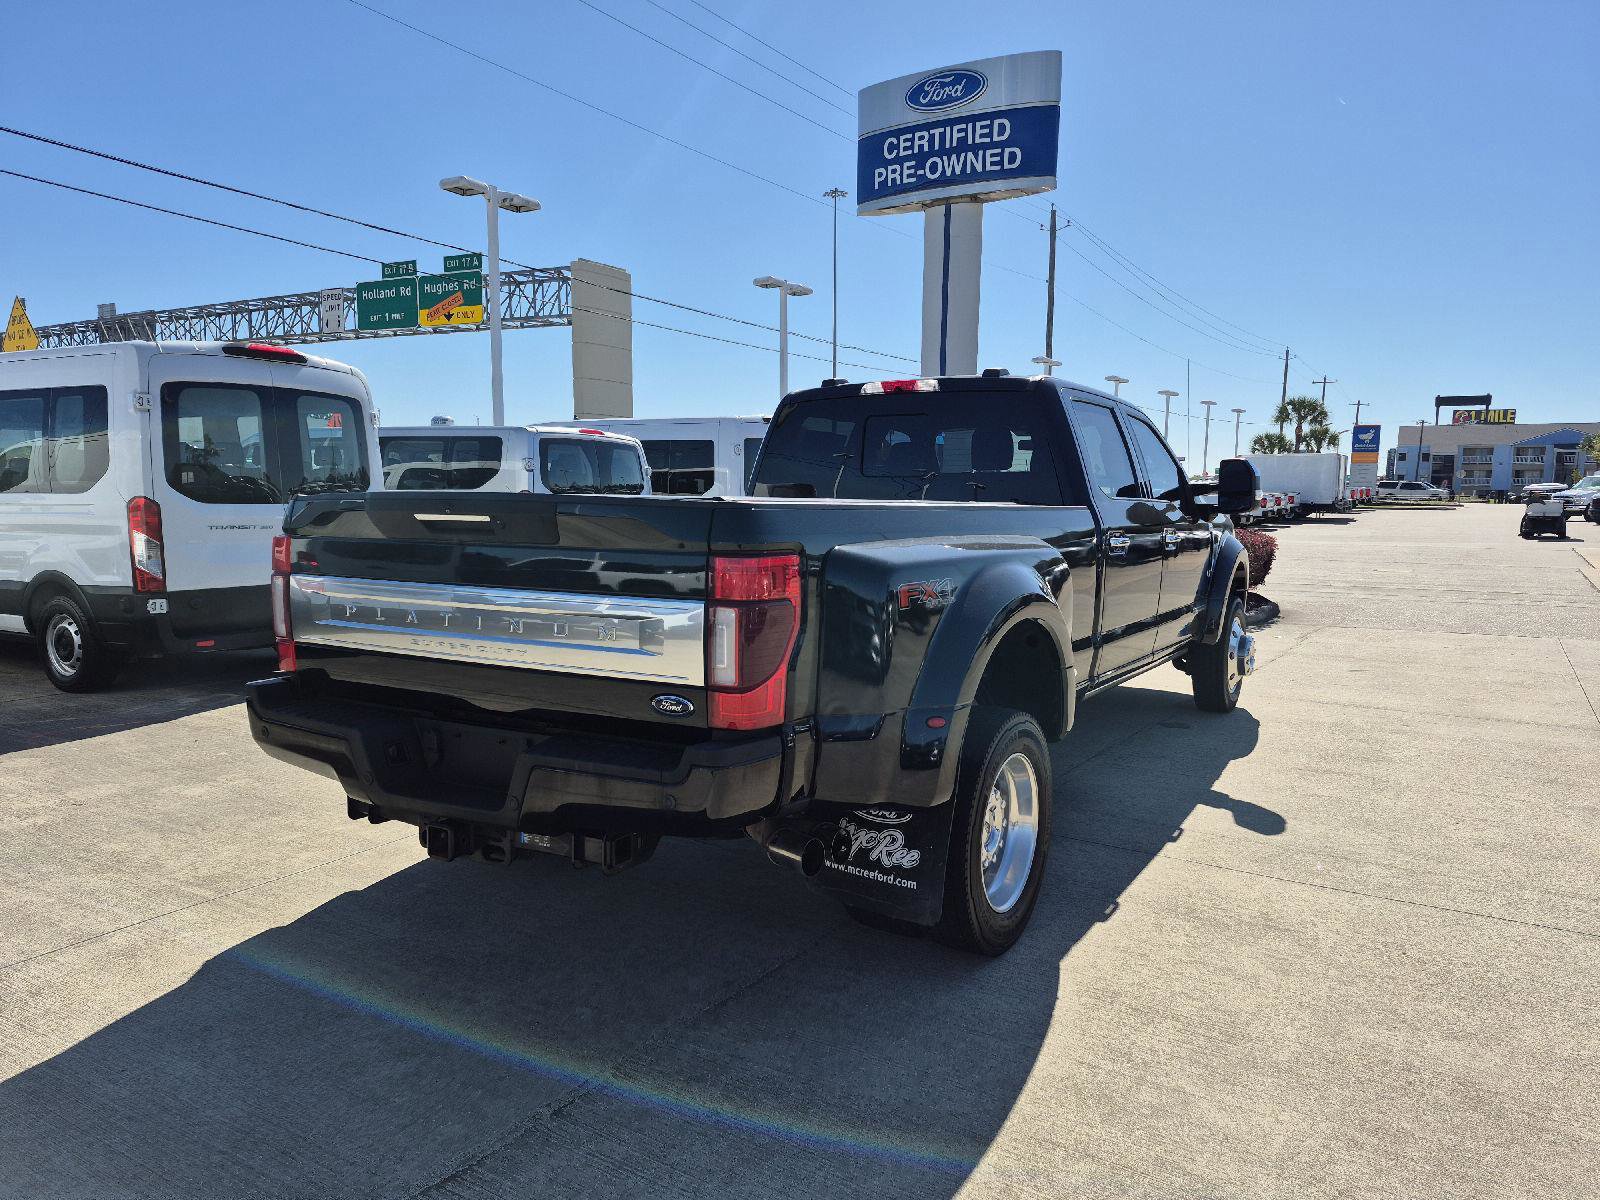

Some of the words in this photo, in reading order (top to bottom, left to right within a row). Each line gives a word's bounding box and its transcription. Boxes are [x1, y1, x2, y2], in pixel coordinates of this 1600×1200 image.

[920, 76, 965, 104] Ford
[883, 118, 1011, 160] CERTIFIED
[874, 147, 1022, 190] PRE-OWNED
[384, 265, 396, 275] EXIT
[446, 259, 459, 268] EXIT
[362, 286, 396, 301] Holland
[400, 285, 412, 297] Rd
[424, 281, 459, 295] Hughes
[463, 278, 476, 290] Rd
[322, 293, 342, 302] SPEED
[385, 312, 389, 322] 1
[456, 310, 475, 319] ONLY
[1488, 409, 1515, 423] MILE
[898, 577, 954, 610] FX4
[344, 603, 618, 641] PLATINUM
[824, 859, 917, 890] www.mcreeford.com
